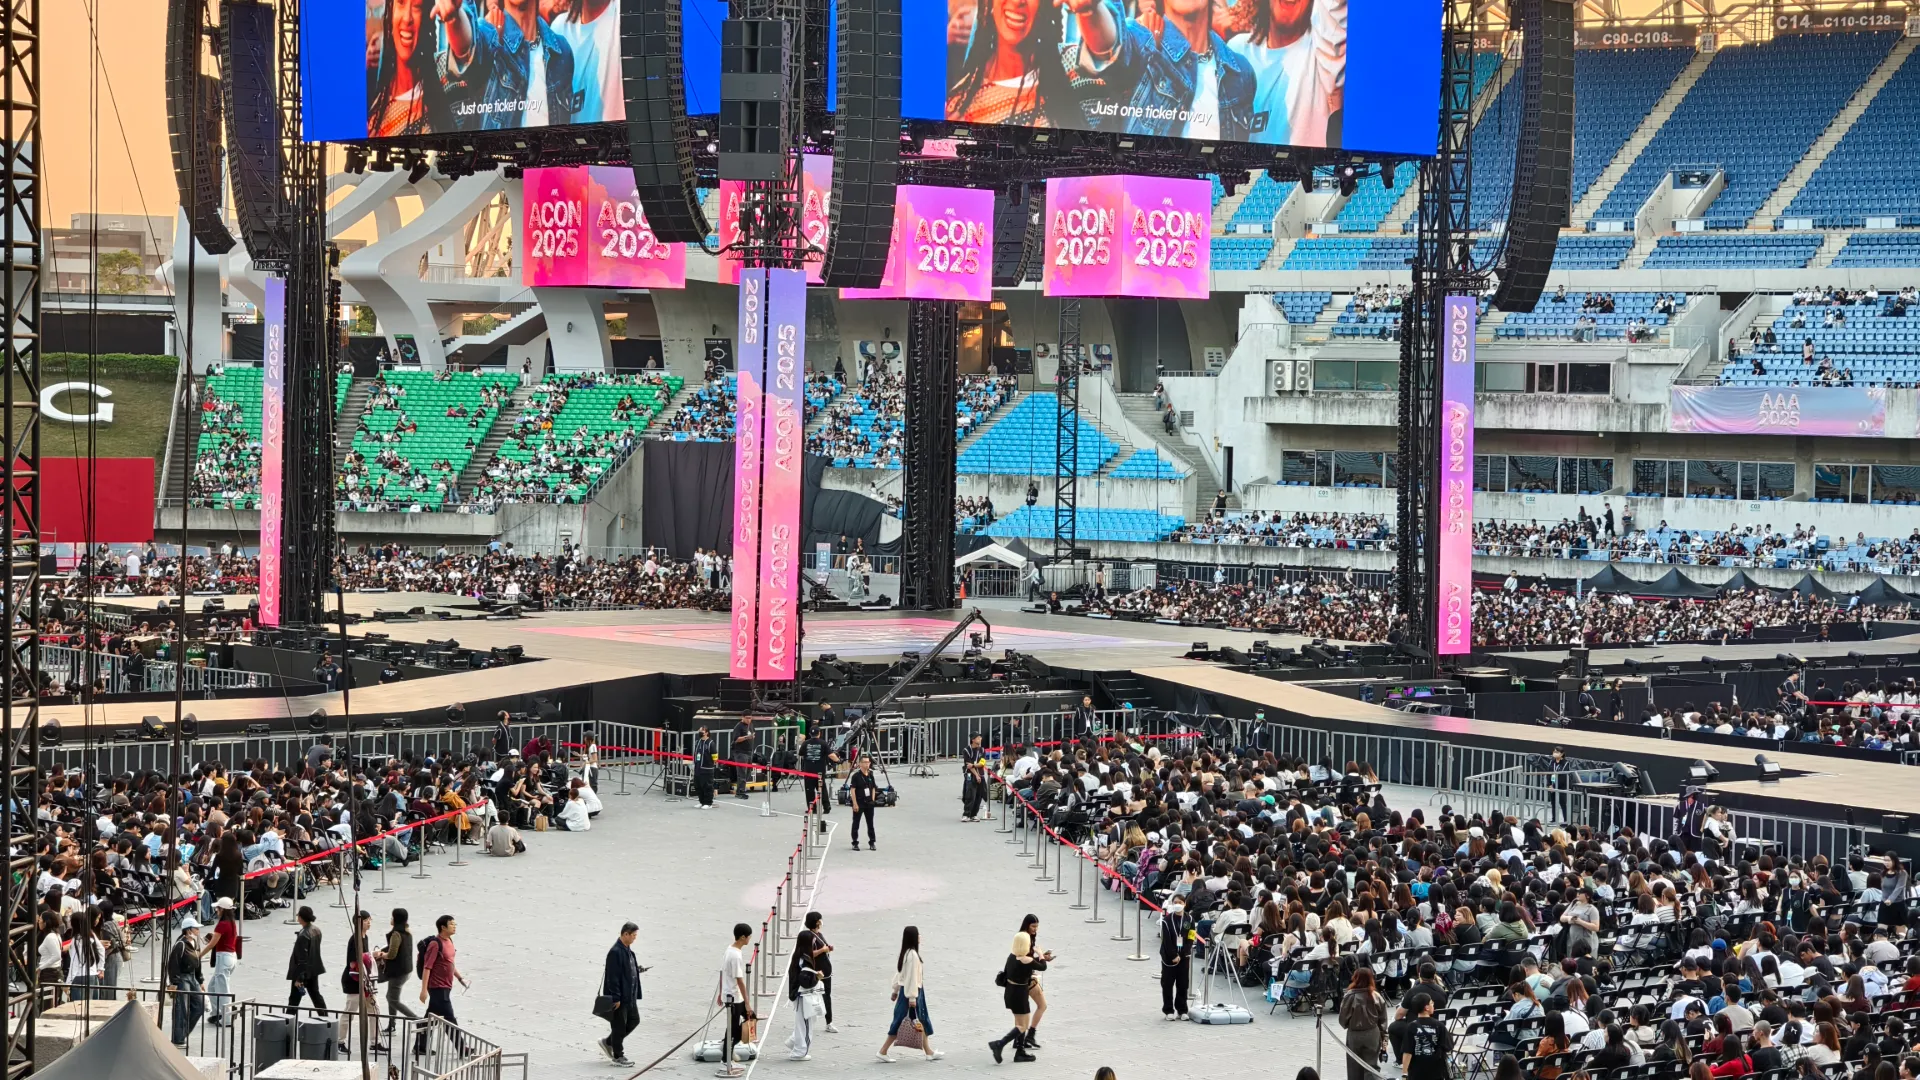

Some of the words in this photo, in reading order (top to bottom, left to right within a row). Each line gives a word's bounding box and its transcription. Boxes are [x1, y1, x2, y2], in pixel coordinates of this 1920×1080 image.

[1602, 31, 1669, 45] C90-C108
[1776, 14, 1810, 30] C14
[1823, 15, 1891, 28] C110-C128
[457, 102, 476, 116] Just
[476, 104, 493, 114] one
[493, 98, 518, 112] ticket
[518, 100, 542, 114] away
[1091, 101, 1118, 115] Just
[1120, 105, 1143, 117] one
[1144, 105, 1177, 120] ticket
[1179, 110, 1213, 126] away
[528, 200, 582, 228] ACON
[914, 218, 985, 247] ACON
[1052, 207, 1115, 236] ACON
[1131, 208, 1203, 239] ACON
[531, 228, 579, 259] 2025
[917, 245, 980, 274] 2025
[1055, 237, 1111, 266] 2025
[1134, 237, 1197, 269] 2025
[744, 278, 759, 344] 2025
[1452, 304, 1468, 363] 2025
[268, 323, 279, 380] 2025
[776, 323, 796, 390] 2025
[40, 382, 114, 422] G
[268, 386, 279, 449] ACON
[1758, 410, 1800, 426] 2025
[1759, 392, 1800, 410] AAA
[741, 397, 755, 470] ACON
[775, 398, 794, 472] ACON
[1449, 407, 1465, 472] ACON
[265, 492, 277, 548] 2025
[740, 477, 753, 543] 2025
[1448, 479, 1464, 536] 2025
[770, 523, 790, 590] 2025
[264, 554, 275, 617] ACON
[1447, 580, 1462, 645] ACON
[736, 594, 749, 669] ACON
[768, 597, 788, 671] ACON
